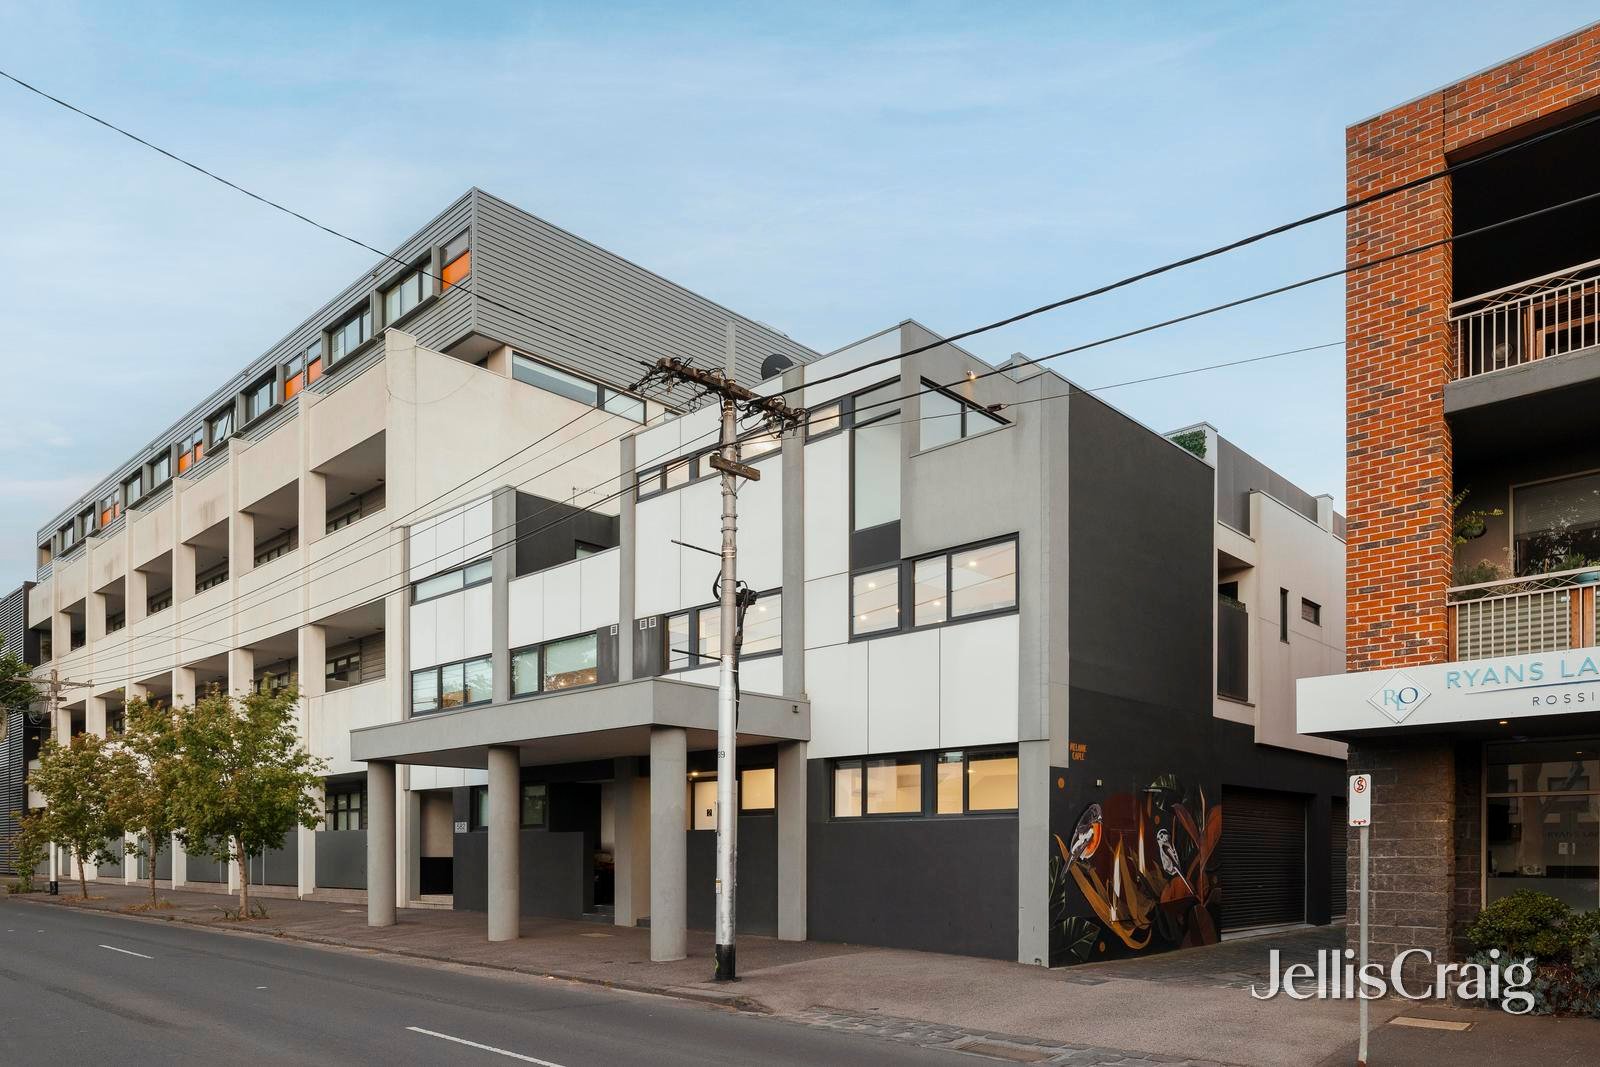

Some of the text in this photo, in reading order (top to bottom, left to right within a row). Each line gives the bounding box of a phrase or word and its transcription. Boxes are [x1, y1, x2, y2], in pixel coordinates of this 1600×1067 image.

[1447, 656, 1600, 689] RYANS LA
[1532, 691, 1595, 706] ROSSI
